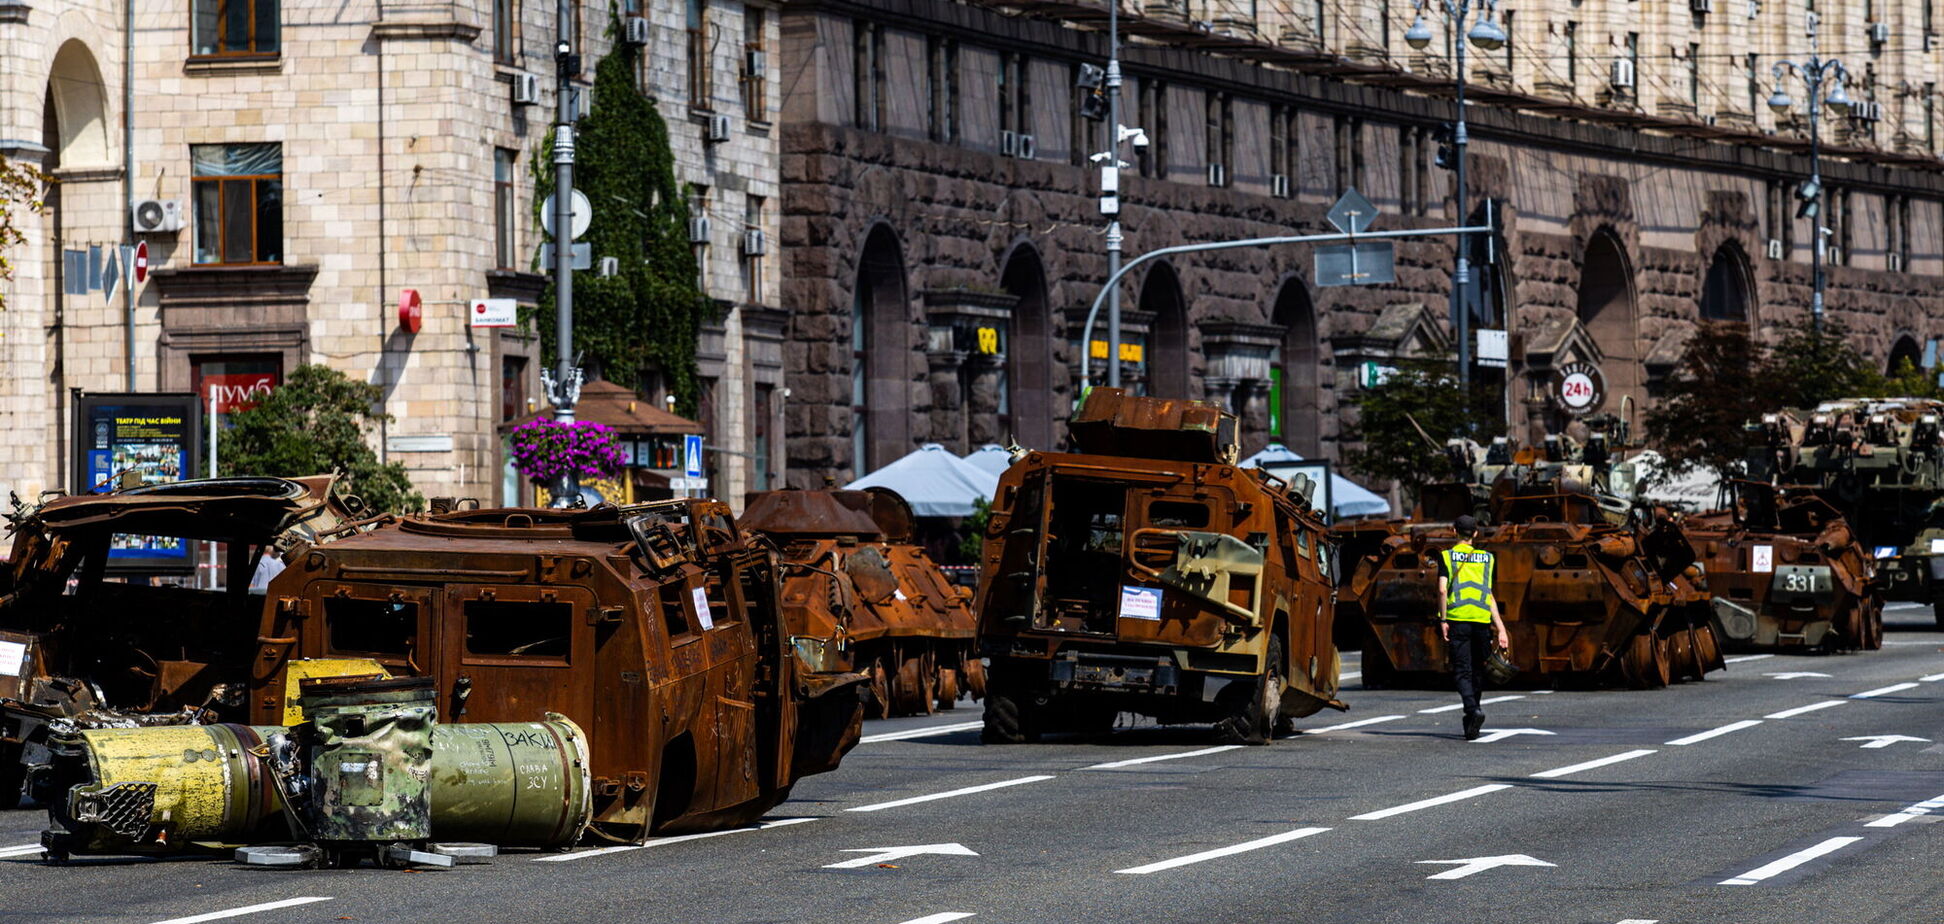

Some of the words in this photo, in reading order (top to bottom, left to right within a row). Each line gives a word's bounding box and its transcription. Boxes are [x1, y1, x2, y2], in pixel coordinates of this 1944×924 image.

[134, 417, 146, 425] ПІД
[161, 416, 181, 424] ВІЙНИ
[1786, 574, 1816, 592] 331
[519, 764, 548, 775] СЛАВА
